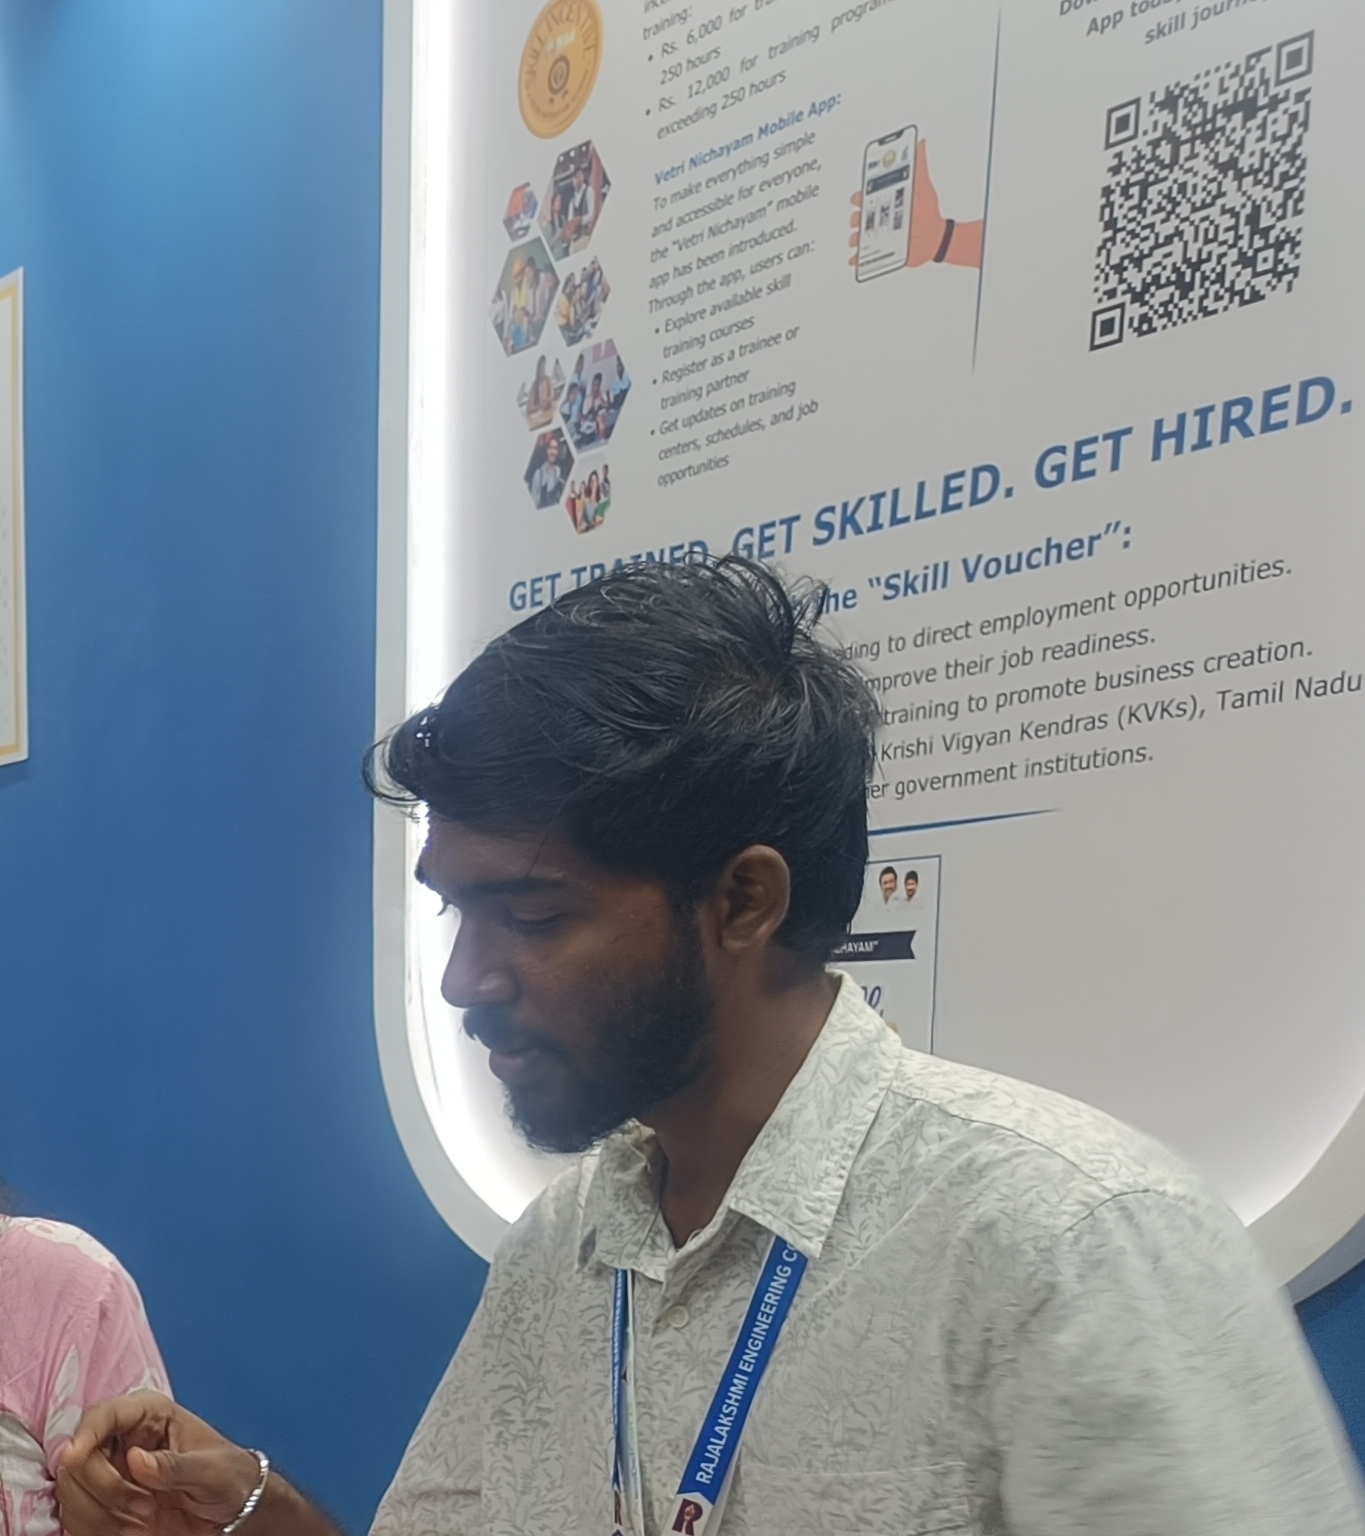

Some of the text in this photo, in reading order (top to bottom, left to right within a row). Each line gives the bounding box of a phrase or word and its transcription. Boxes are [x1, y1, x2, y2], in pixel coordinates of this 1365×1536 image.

[643, 6, 693, 40] training:
[686, 15, 722, 46] 6,000
[728, 4, 747, 24] for
[1086, 9, 1124, 37] App
[1144, 10, 1187, 45] skill
[660, 45, 721, 86] 250 hours
[687, 65, 731, 99] 12,000
[739, 54, 759, 75] for
[768, 24, 821, 60] training
[657, 69, 787, 140] exceeding 250 hours
[655, 93, 842, 185] Vetri Nichayam Mobile App:
[653, 130, 817, 211] To make everything simple
[650, 245, 670, 264] the
[776, 182, 820, 212] mobile
[651, 216, 674, 238] and
[675, 191, 735, 228] accessible
[737, 184, 754, 202] for
[648, 271, 670, 290] app
[672, 262, 693, 280] has
[696, 249, 726, 271] been
[648, 239, 816, 315] Through the app, users can:
[664, 272, 792, 335] Explore available skill
[661, 325, 801, 385] Register as a trainee or
[662, 315, 756, 360] training courses
[659, 380, 797, 436] Get updates on training
[660, 368, 751, 411] training partner
[658, 397, 820, 461] centers, schedules, and job
[509, 573, 562, 613] GET
[732, 514, 802, 562] GET
[811, 463, 1015, 547] SKILLED.
[1033, 426, 1134, 491] GET
[1150, 375, 1354, 463] HIRED.
[657, 453, 731, 489] opportunities
[819, 585, 858, 616] he
[887, 634, 907, 654] to
[913, 620, 973, 650] direct
[979, 590, 1117, 637] employment
[1124, 559, 1293, 611] opportunities.
[945, 655, 994, 680] their
[998, 646, 1034, 677] job
[1041, 627, 1156, 663] readiness.
[883, 639, 1314, 727] training to promote business creation.
[880, 670, 1364, 763] Krishi Vigyan Kendras (KVKs), Tamil Nadu
[894, 761, 1018, 801] government
[1024, 745, 1155, 778] institutions.
[695, 1373, 749, 1485] RAJALAKSHMI
[738, 1264, 793, 1374] ENGINEERING
